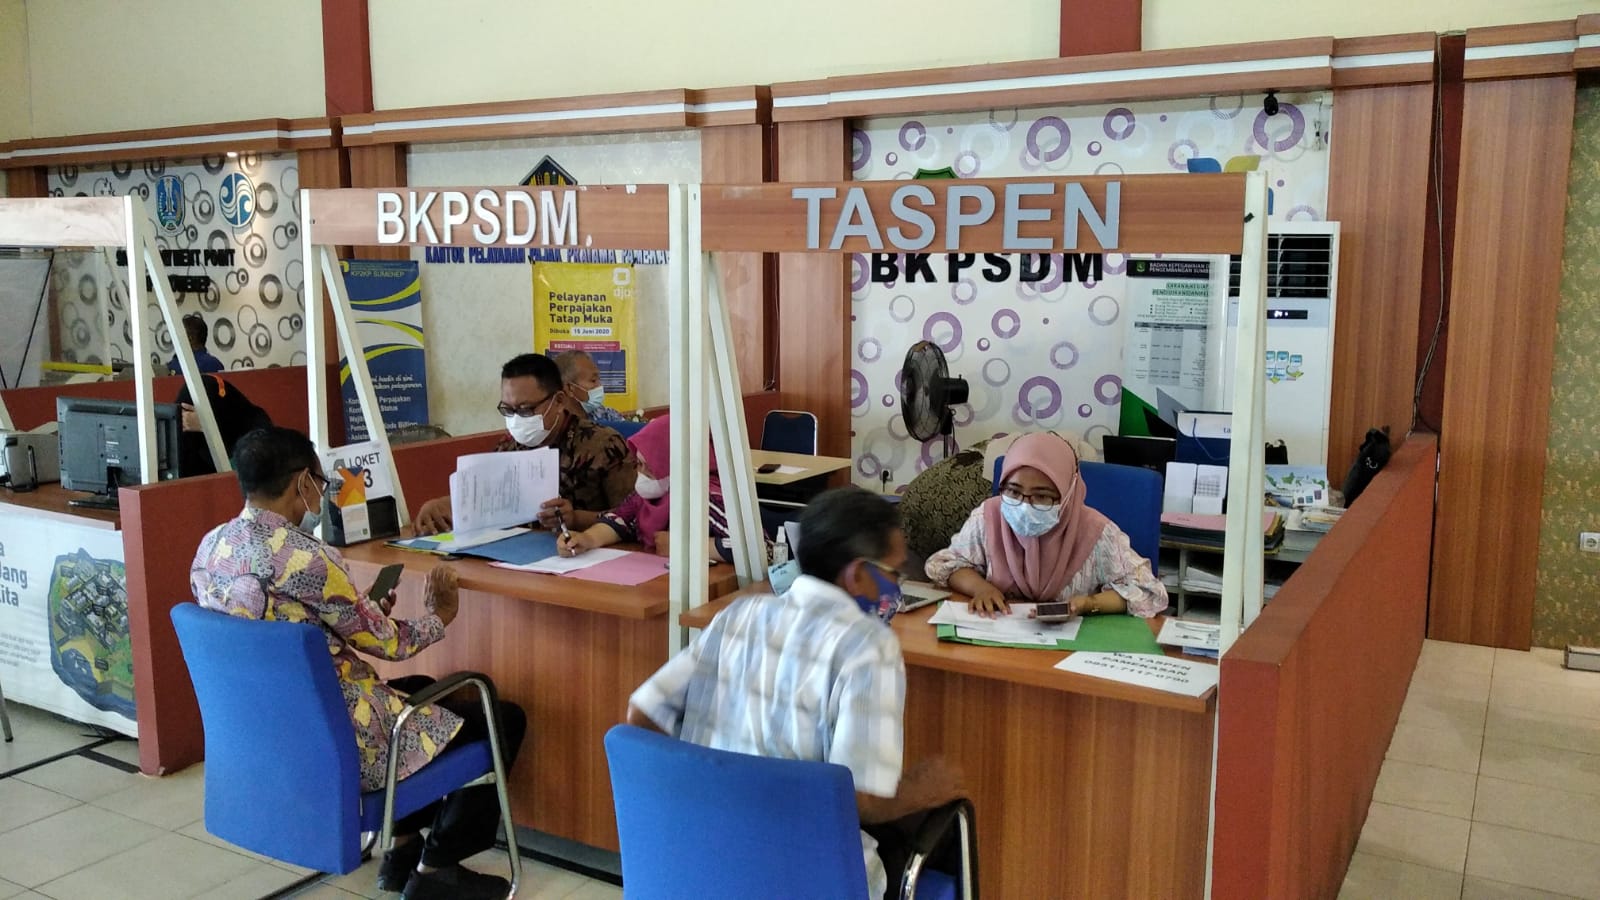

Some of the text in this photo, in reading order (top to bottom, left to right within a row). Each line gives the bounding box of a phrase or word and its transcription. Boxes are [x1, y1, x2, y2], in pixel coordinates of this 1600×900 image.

[376, 189, 578, 245] BKPSDM
[791, 182, 1121, 250] TASPEN
[549, 291, 606, 303] Pelayanan
[549, 303, 612, 314] Perpajakan
[549, 314, 613, 325] Tatap Muka
[348, 451, 380, 467] LOKET
[363, 468, 373, 488] 3
[1102, 656, 1188, 676] PAMEKASAN
[1138, 657, 1192, 671] TASPEN
